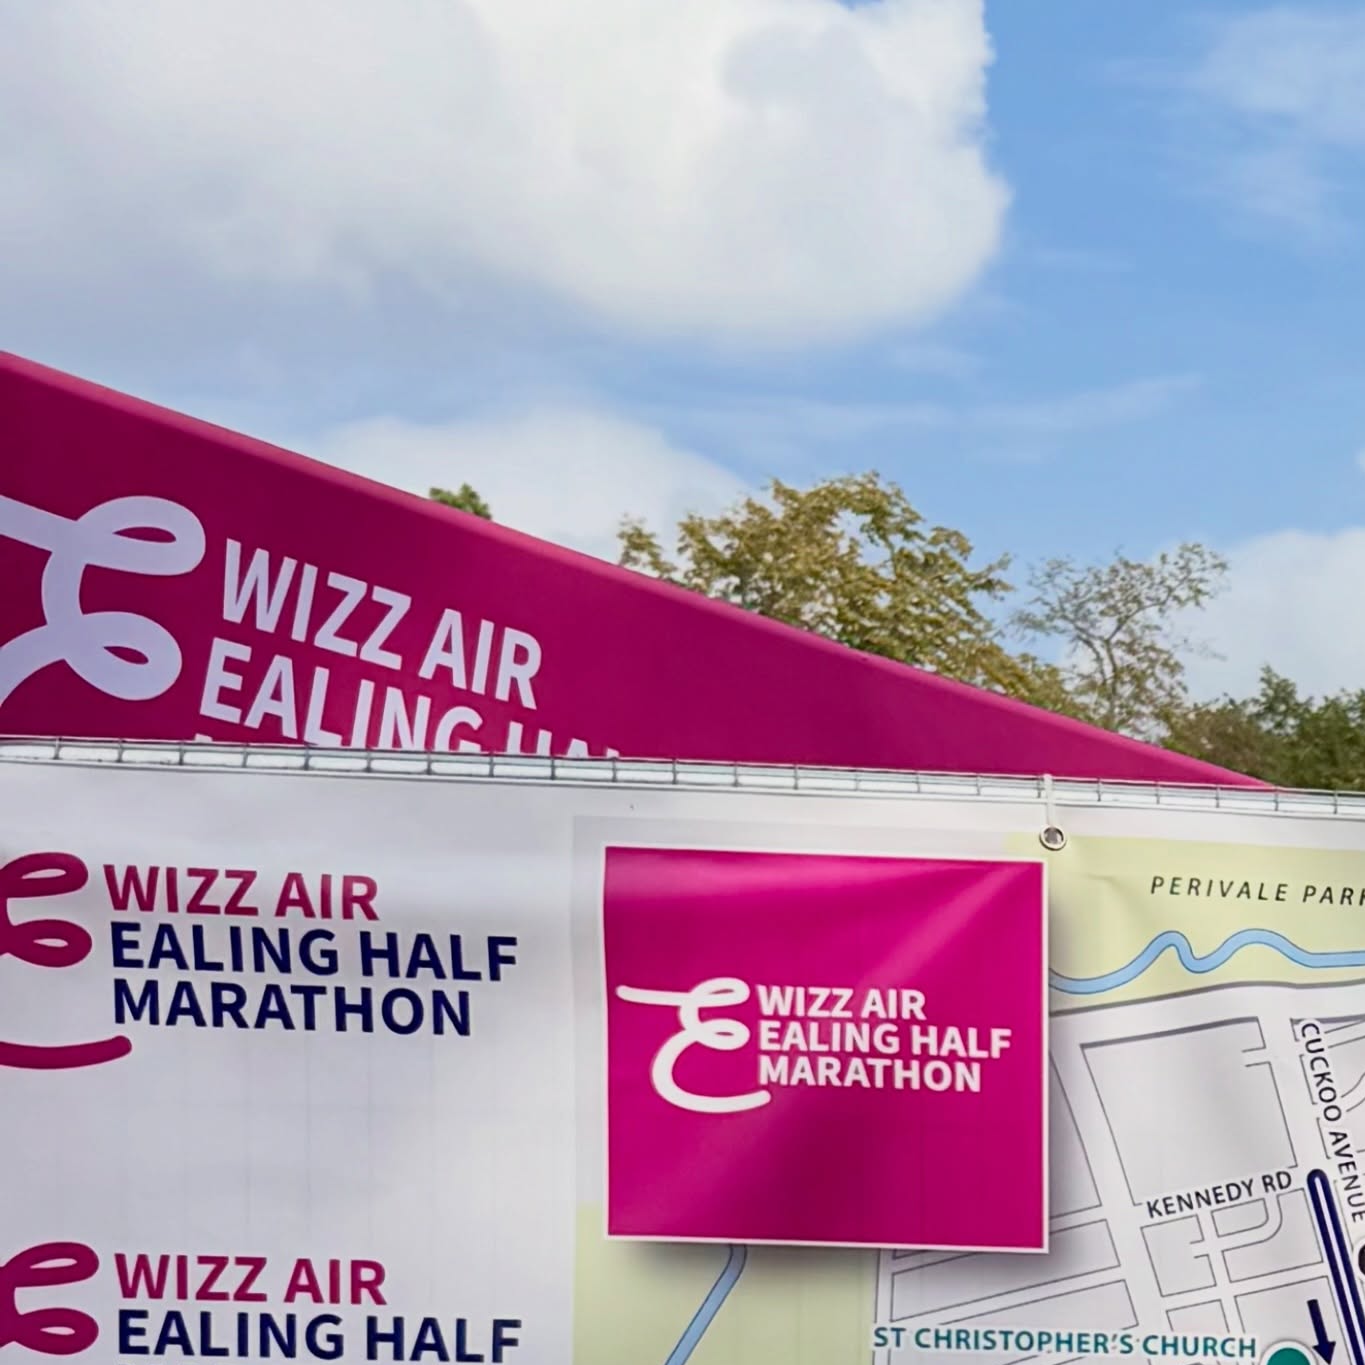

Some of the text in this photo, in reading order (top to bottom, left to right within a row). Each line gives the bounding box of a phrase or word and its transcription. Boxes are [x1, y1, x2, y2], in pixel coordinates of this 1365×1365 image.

[223, 538, 541, 709] WIZZ AIR
[200, 638, 483, 751] EALING
[103, 865, 378, 920] WIZZ AIR
[1150, 876, 1288, 901] PERIVALE
[110, 922, 517, 980] EALING HALF
[114, 980, 470, 1035] MARATHON
[757, 985, 926, 1019] WIZZ AIR
[760, 1020, 1011, 1058] EALING HALF
[760, 1055, 981, 1092] MARATHON
[1147, 1172, 1292, 1218] KENNEDY RD
[874, 1328, 1256, 1358] ST CHRISTOPHER'S CHURCH
